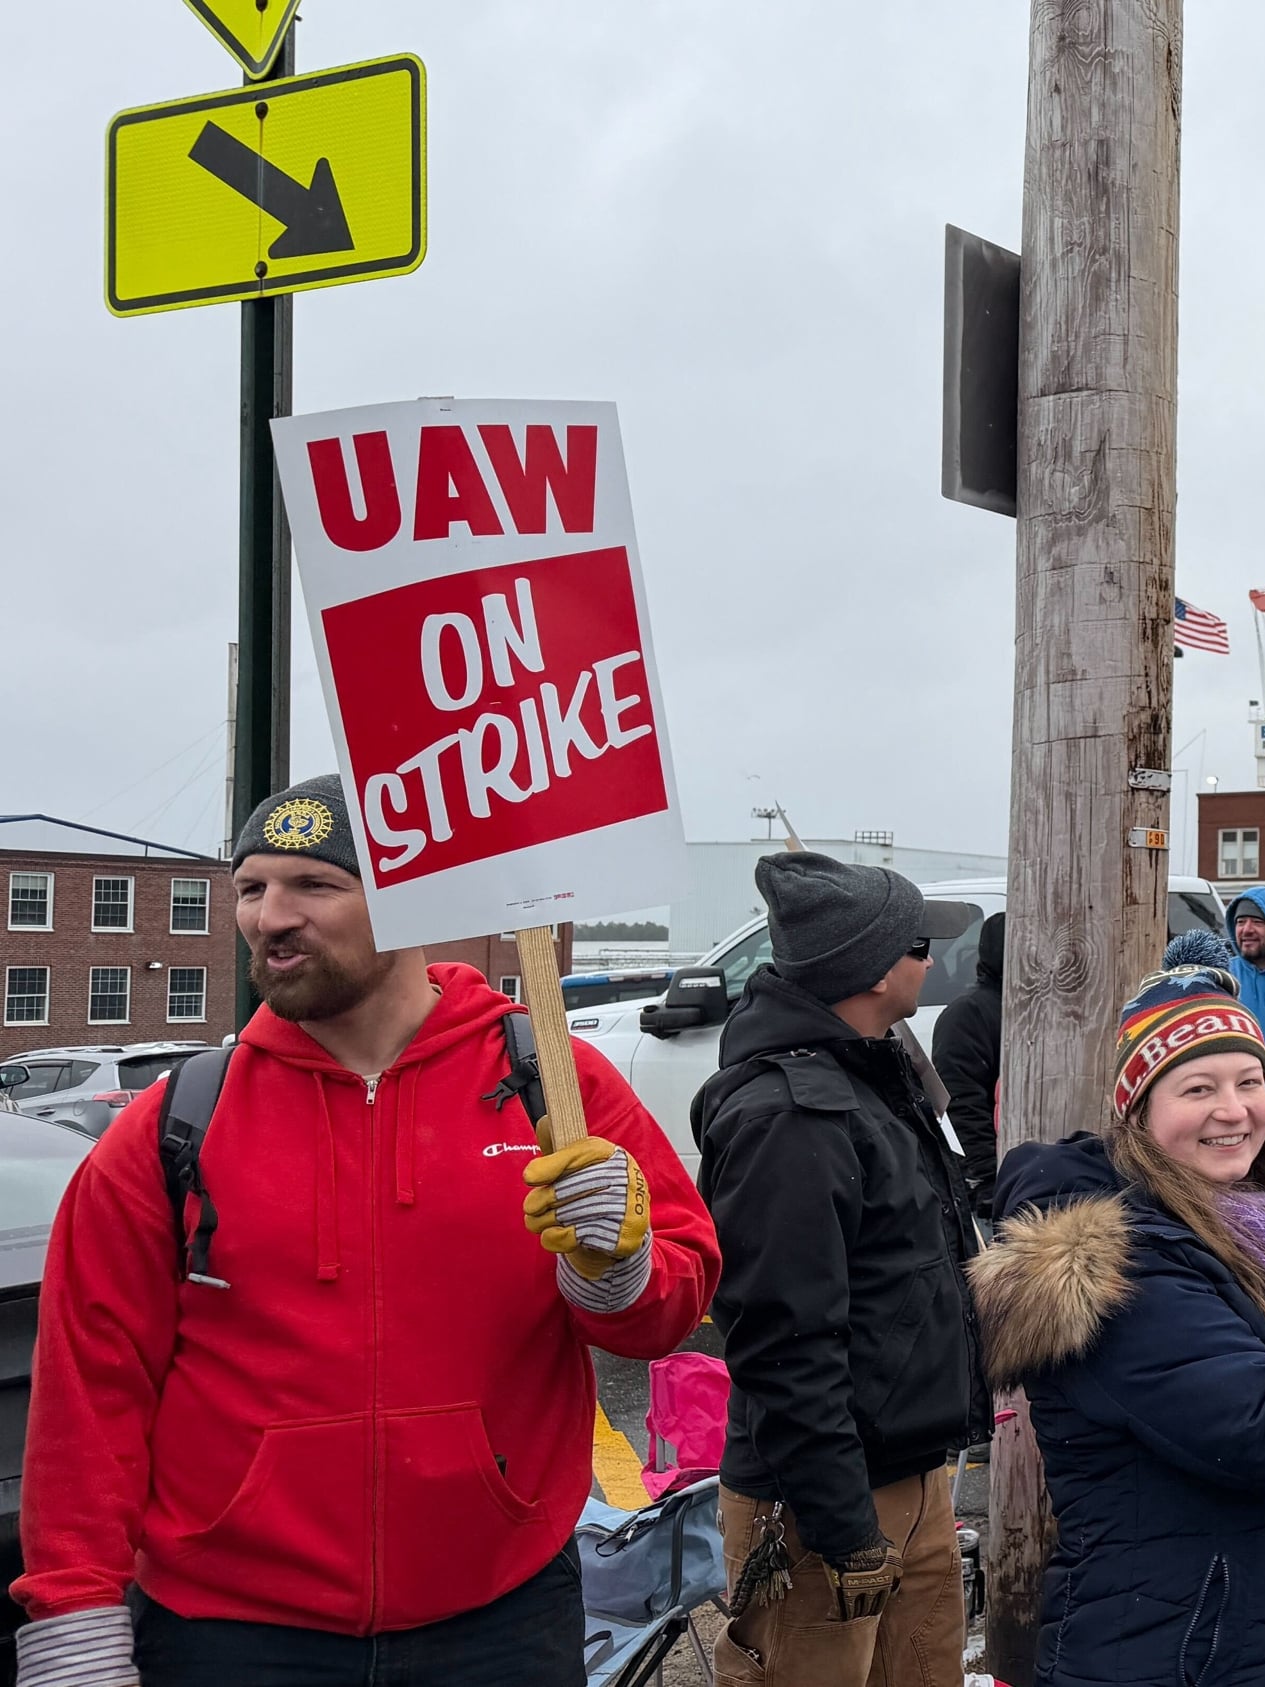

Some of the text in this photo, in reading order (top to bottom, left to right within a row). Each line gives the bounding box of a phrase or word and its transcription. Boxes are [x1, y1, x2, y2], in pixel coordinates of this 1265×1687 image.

[306, 424, 599, 552] UAW
[420, 577, 545, 712] ON
[364, 650, 653, 873] STRIKE
[633, 1167, 646, 1216] KINCO
